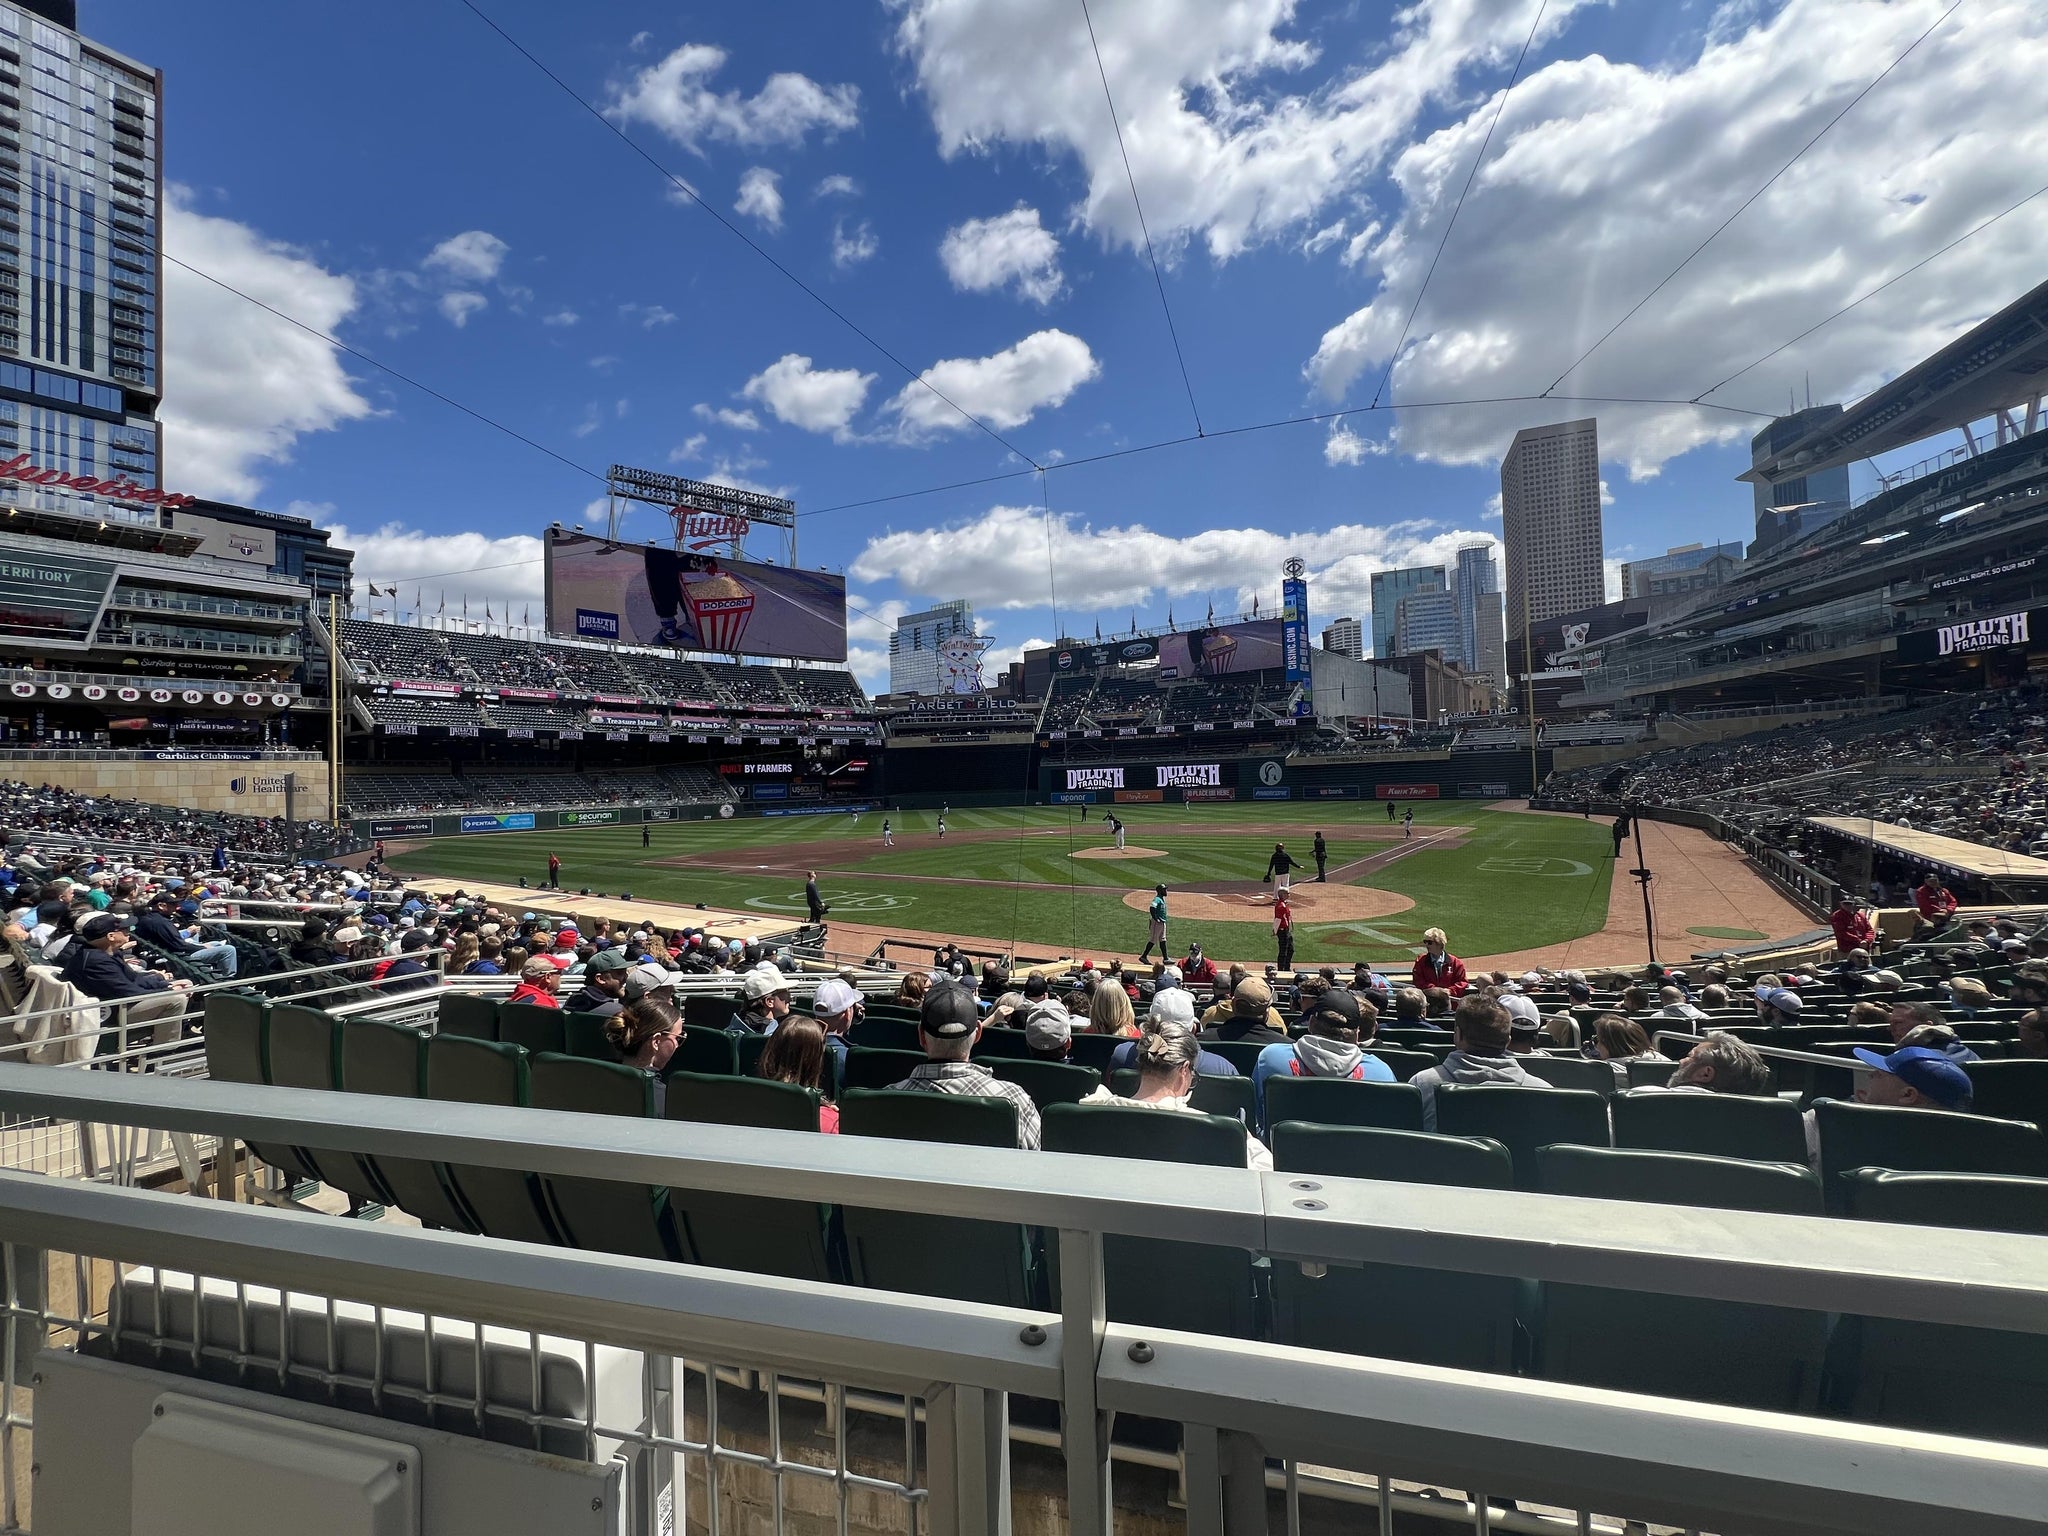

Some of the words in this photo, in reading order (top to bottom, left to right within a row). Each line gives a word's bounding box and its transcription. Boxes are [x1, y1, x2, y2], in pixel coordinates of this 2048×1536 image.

[255, 510, 275, 519] PIPER
[670, 506, 751, 542] Twins
[1992, 567, 2001, 575] SO
[2001, 563, 2016, 572] OUR
[2017, 558, 2036, 568] NEXT
[703, 599, 748, 610] POPCORN
[579, 615, 616, 632] DULUTH
[1937, 611, 2030, 655] DULUTH
[941, 641, 959, 652] Win!
[959, 640, 985, 651] Twins!
[1955, 634, 2010, 652] TRADING
[1128, 647, 1147, 655] Ford
[1287, 627, 1298, 670] CHSINC.COM
[1544, 665, 1575, 673] TARGET
[55, 687, 63, 695] 7
[401, 682, 433, 690] Treasure
[433, 683, 455, 692] Island
[155, 692, 168, 700] 34
[186, 693, 197, 701] 14
[509, 690, 549, 698] Ticasino.com
[909, 701, 963, 711] TARGET
[977, 700, 1018, 709] FIELD
[1444, 711, 1478, 719] TARGET
[1488, 707, 1518, 715] FIELD
[637, 718, 658, 726] Island
[1601, 737, 1623, 745] Corona
[156, 752, 199, 760] Carbliss
[200, 752, 251, 760] Clubhouse
[720, 764, 743, 774] BUILT
[744, 764, 756, 773] BY
[757, 763, 793, 773] FARMERS
[252, 777, 286, 785] United
[1066, 767, 1125, 790] DULUTH
[1156, 764, 1221, 788] DULUTH
[1168, 776, 1208, 786] TRADING
[252, 784, 309, 793] Healthare
[1077, 779, 1113, 789] TRADING
[1060, 793, 1086, 802] uponor
[1126, 792, 1149, 801] Paycor
[578, 812, 612, 820] securian
